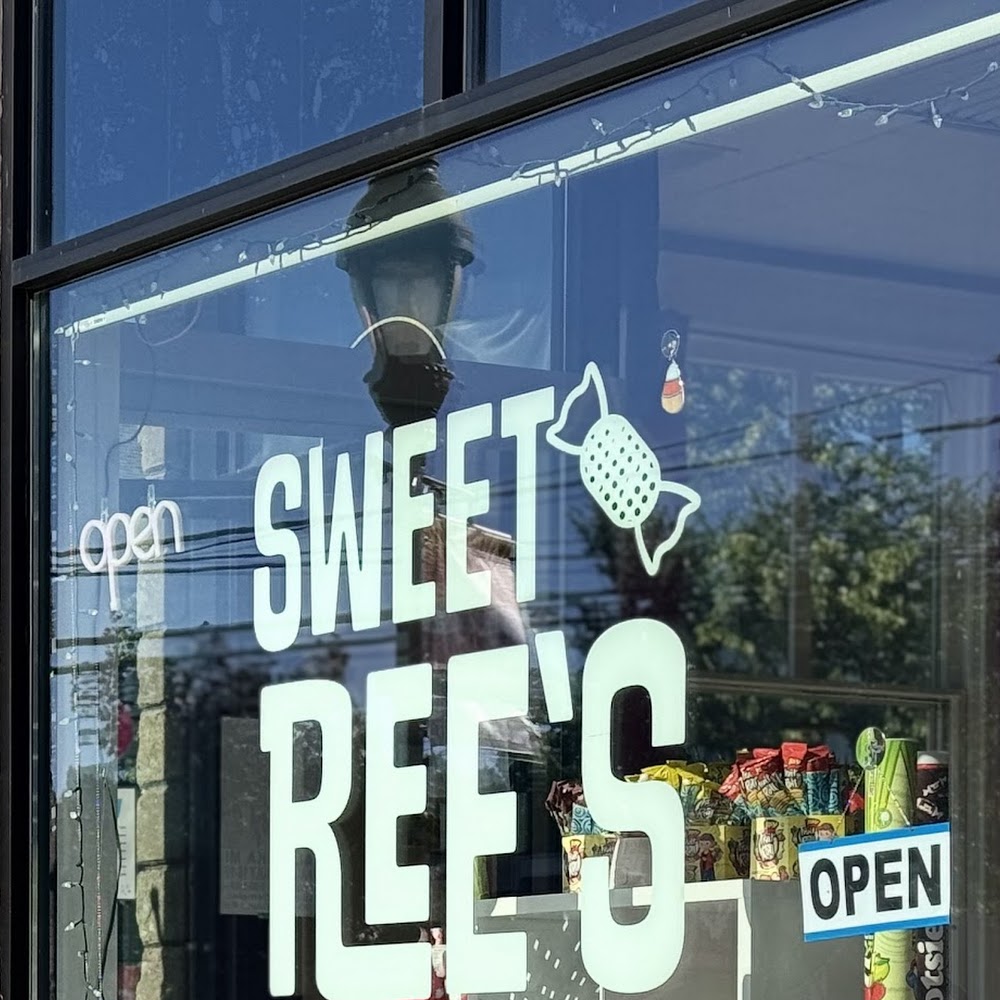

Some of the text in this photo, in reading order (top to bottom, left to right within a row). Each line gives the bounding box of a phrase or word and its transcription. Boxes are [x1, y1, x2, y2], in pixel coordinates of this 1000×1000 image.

[79, 499, 184, 612] open
[253, 385, 555, 652] SWEET
[810, 844, 942, 920] OPEN
